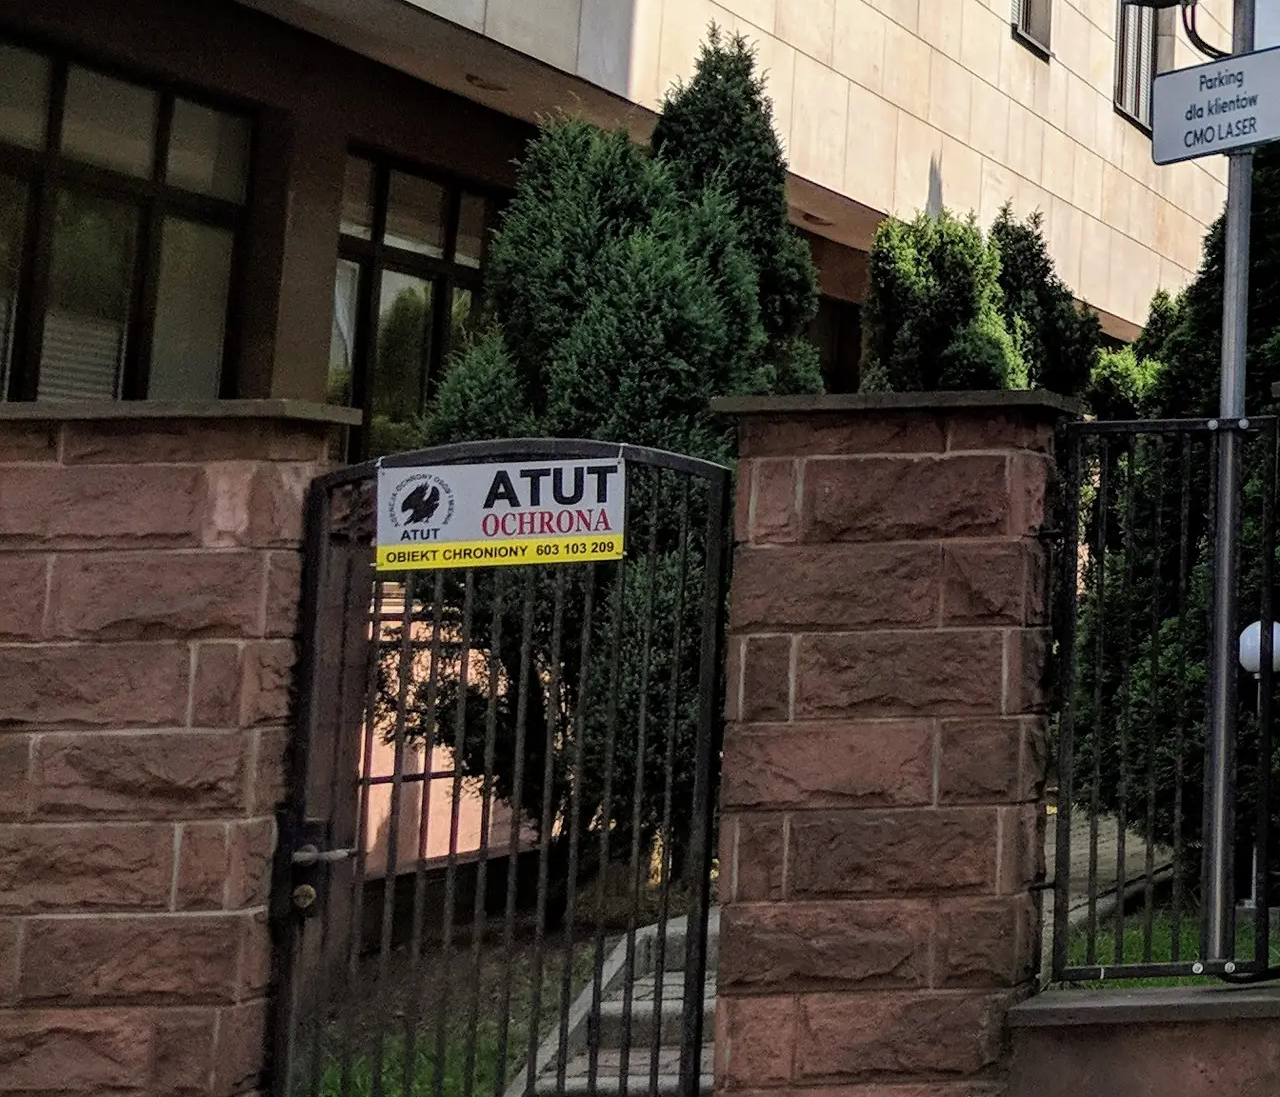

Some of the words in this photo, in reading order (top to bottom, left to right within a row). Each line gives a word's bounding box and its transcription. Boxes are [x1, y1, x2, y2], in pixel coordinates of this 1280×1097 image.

[1199, 69, 1244, 92] Parking
[1185, 103, 1204, 121] dla
[1207, 91, 1259, 116] klientów
[1184, 125, 1215, 148] CMO
[1218, 117, 1257, 141] LASER
[483, 466, 618, 509] ATUT
[400, 528, 440, 541] ATUT
[481, 508, 612, 538] OCHRONA
[386, 548, 440, 564] OBIEKT
[442, 545, 529, 562] CHRONIONY
[536, 543, 559, 556] 603
[564, 542, 587, 555] 103
[591, 541, 614, 553] 209
